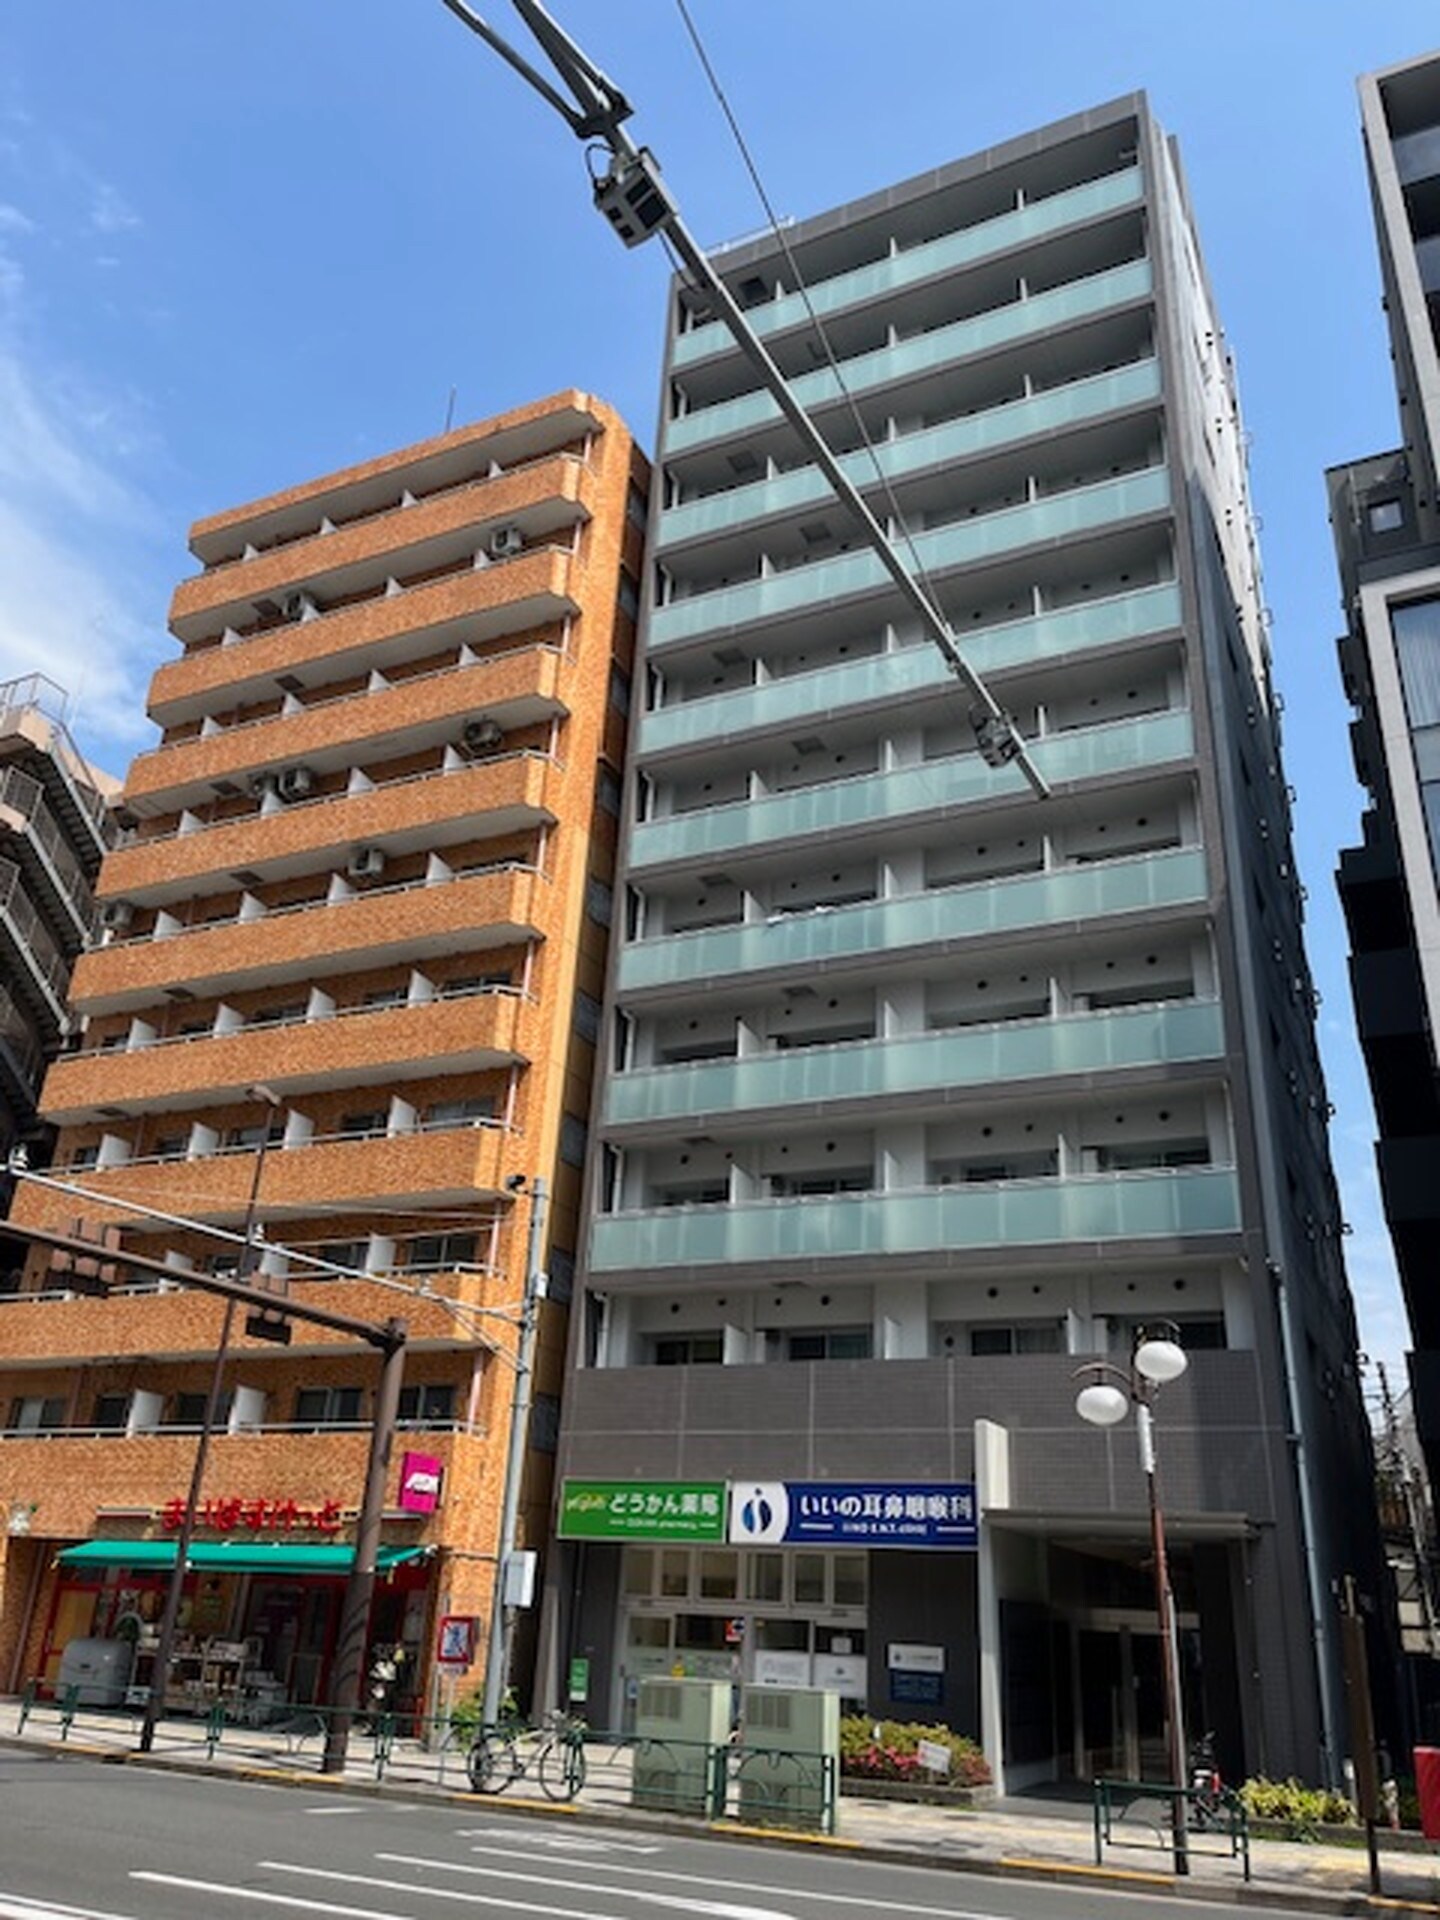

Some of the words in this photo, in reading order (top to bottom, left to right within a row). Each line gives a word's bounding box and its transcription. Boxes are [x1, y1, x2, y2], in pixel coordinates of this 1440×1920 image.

[609, 1493, 719, 1515] どうかん薬局
[800, 1494, 972, 1520] いいの耳鼻咽喉科
